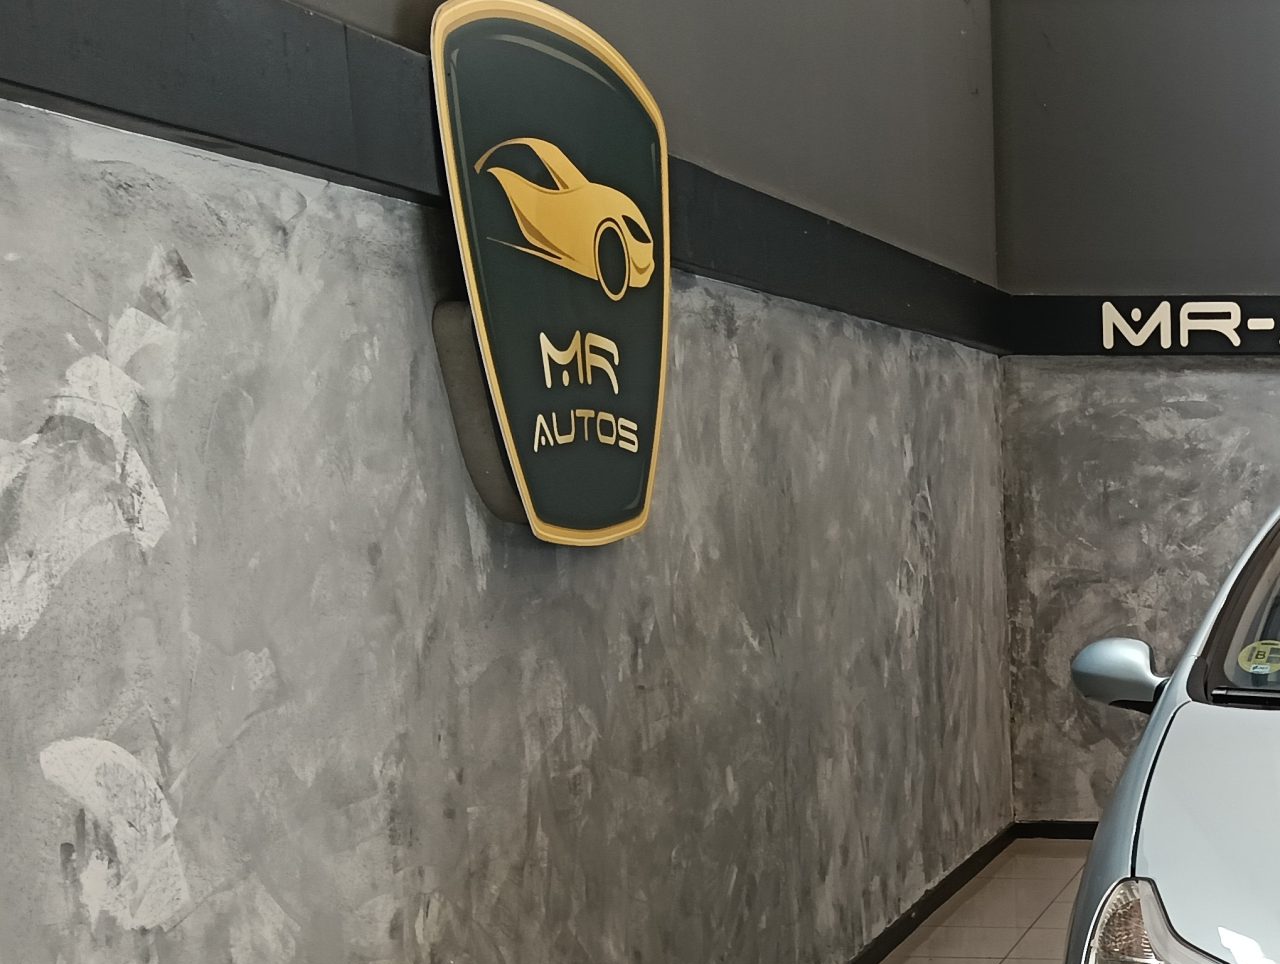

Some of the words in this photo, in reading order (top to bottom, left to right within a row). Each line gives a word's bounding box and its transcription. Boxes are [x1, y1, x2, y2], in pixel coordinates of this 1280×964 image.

[539, 330, 619, 395] MR
[533, 408, 639, 453] AUTOS
[1255, 650, 1267, 660] B
